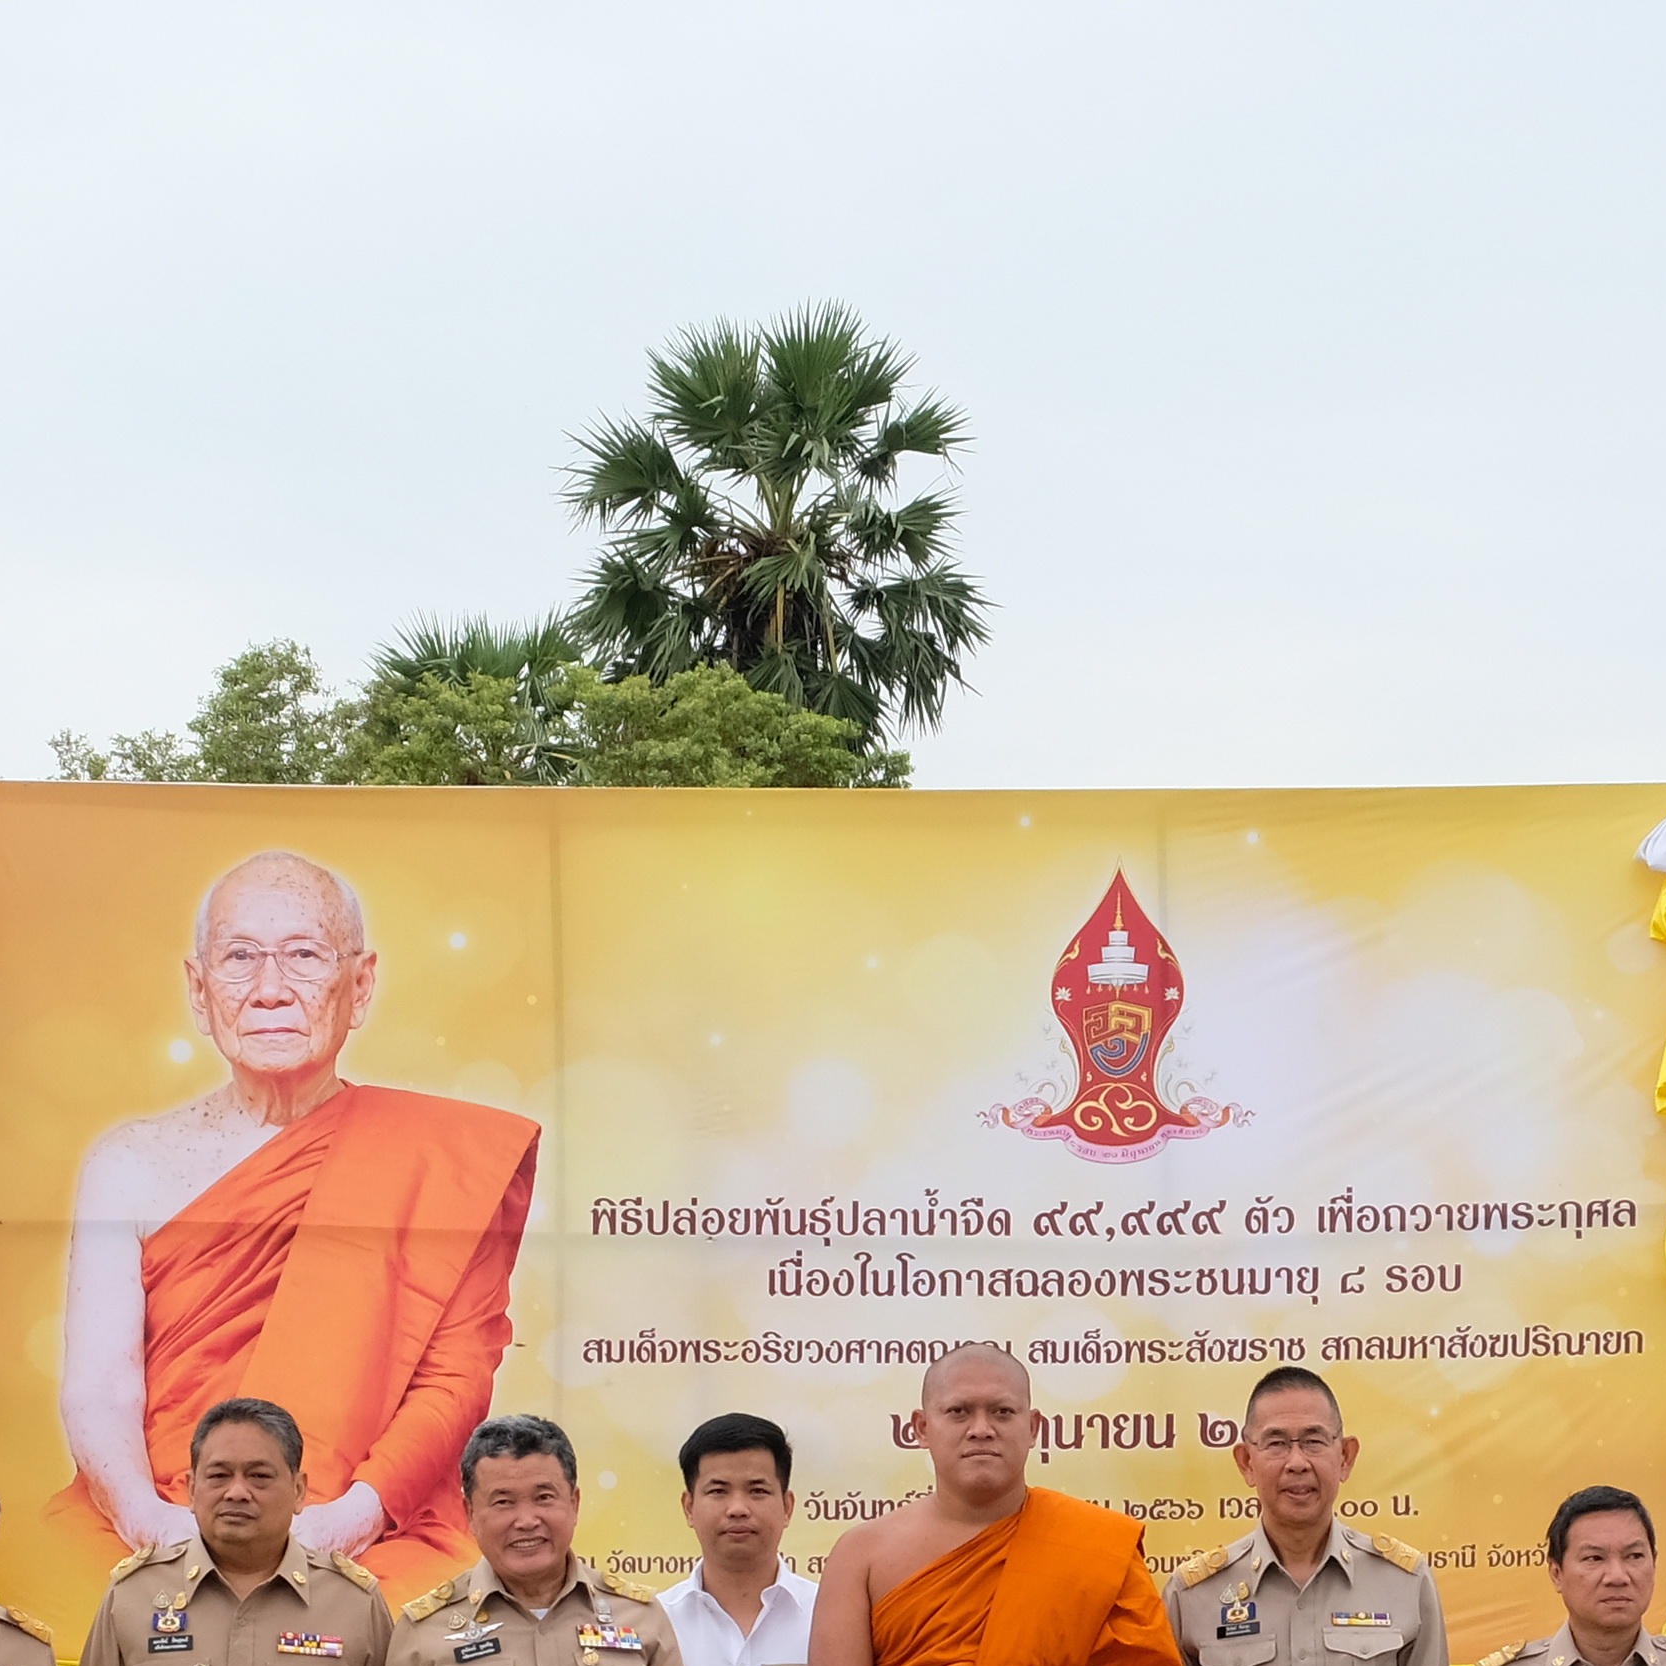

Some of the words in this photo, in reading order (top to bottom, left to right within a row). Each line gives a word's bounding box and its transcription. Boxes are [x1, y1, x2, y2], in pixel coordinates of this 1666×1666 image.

[591, 1188, 1011, 1247] พิธีปล่อยพันธุ์ปลาน้ำจืด
[1244, 1196, 1295, 1234] ตัว
[1318, 1187, 1636, 1239] เพื่อถวายพระกุศล
[768, 1249, 1319, 1305] เนื่องในโอกาสฉลองพระชนมายุ
[1340, 1266, 1365, 1294] ๘
[1385, 1264, 1461, 1293] รอบ
[1028, 1327, 1306, 1365] สมเด็จพระสังฆราช
[1321, 1324, 1643, 1361] สกลมหาสังฆปริณายก
[1219, 1497, 1261, 1519] เวล
[1392, 1494, 1419, 1516] น.
[1487, 1542, 1549, 1568] จังหวั
